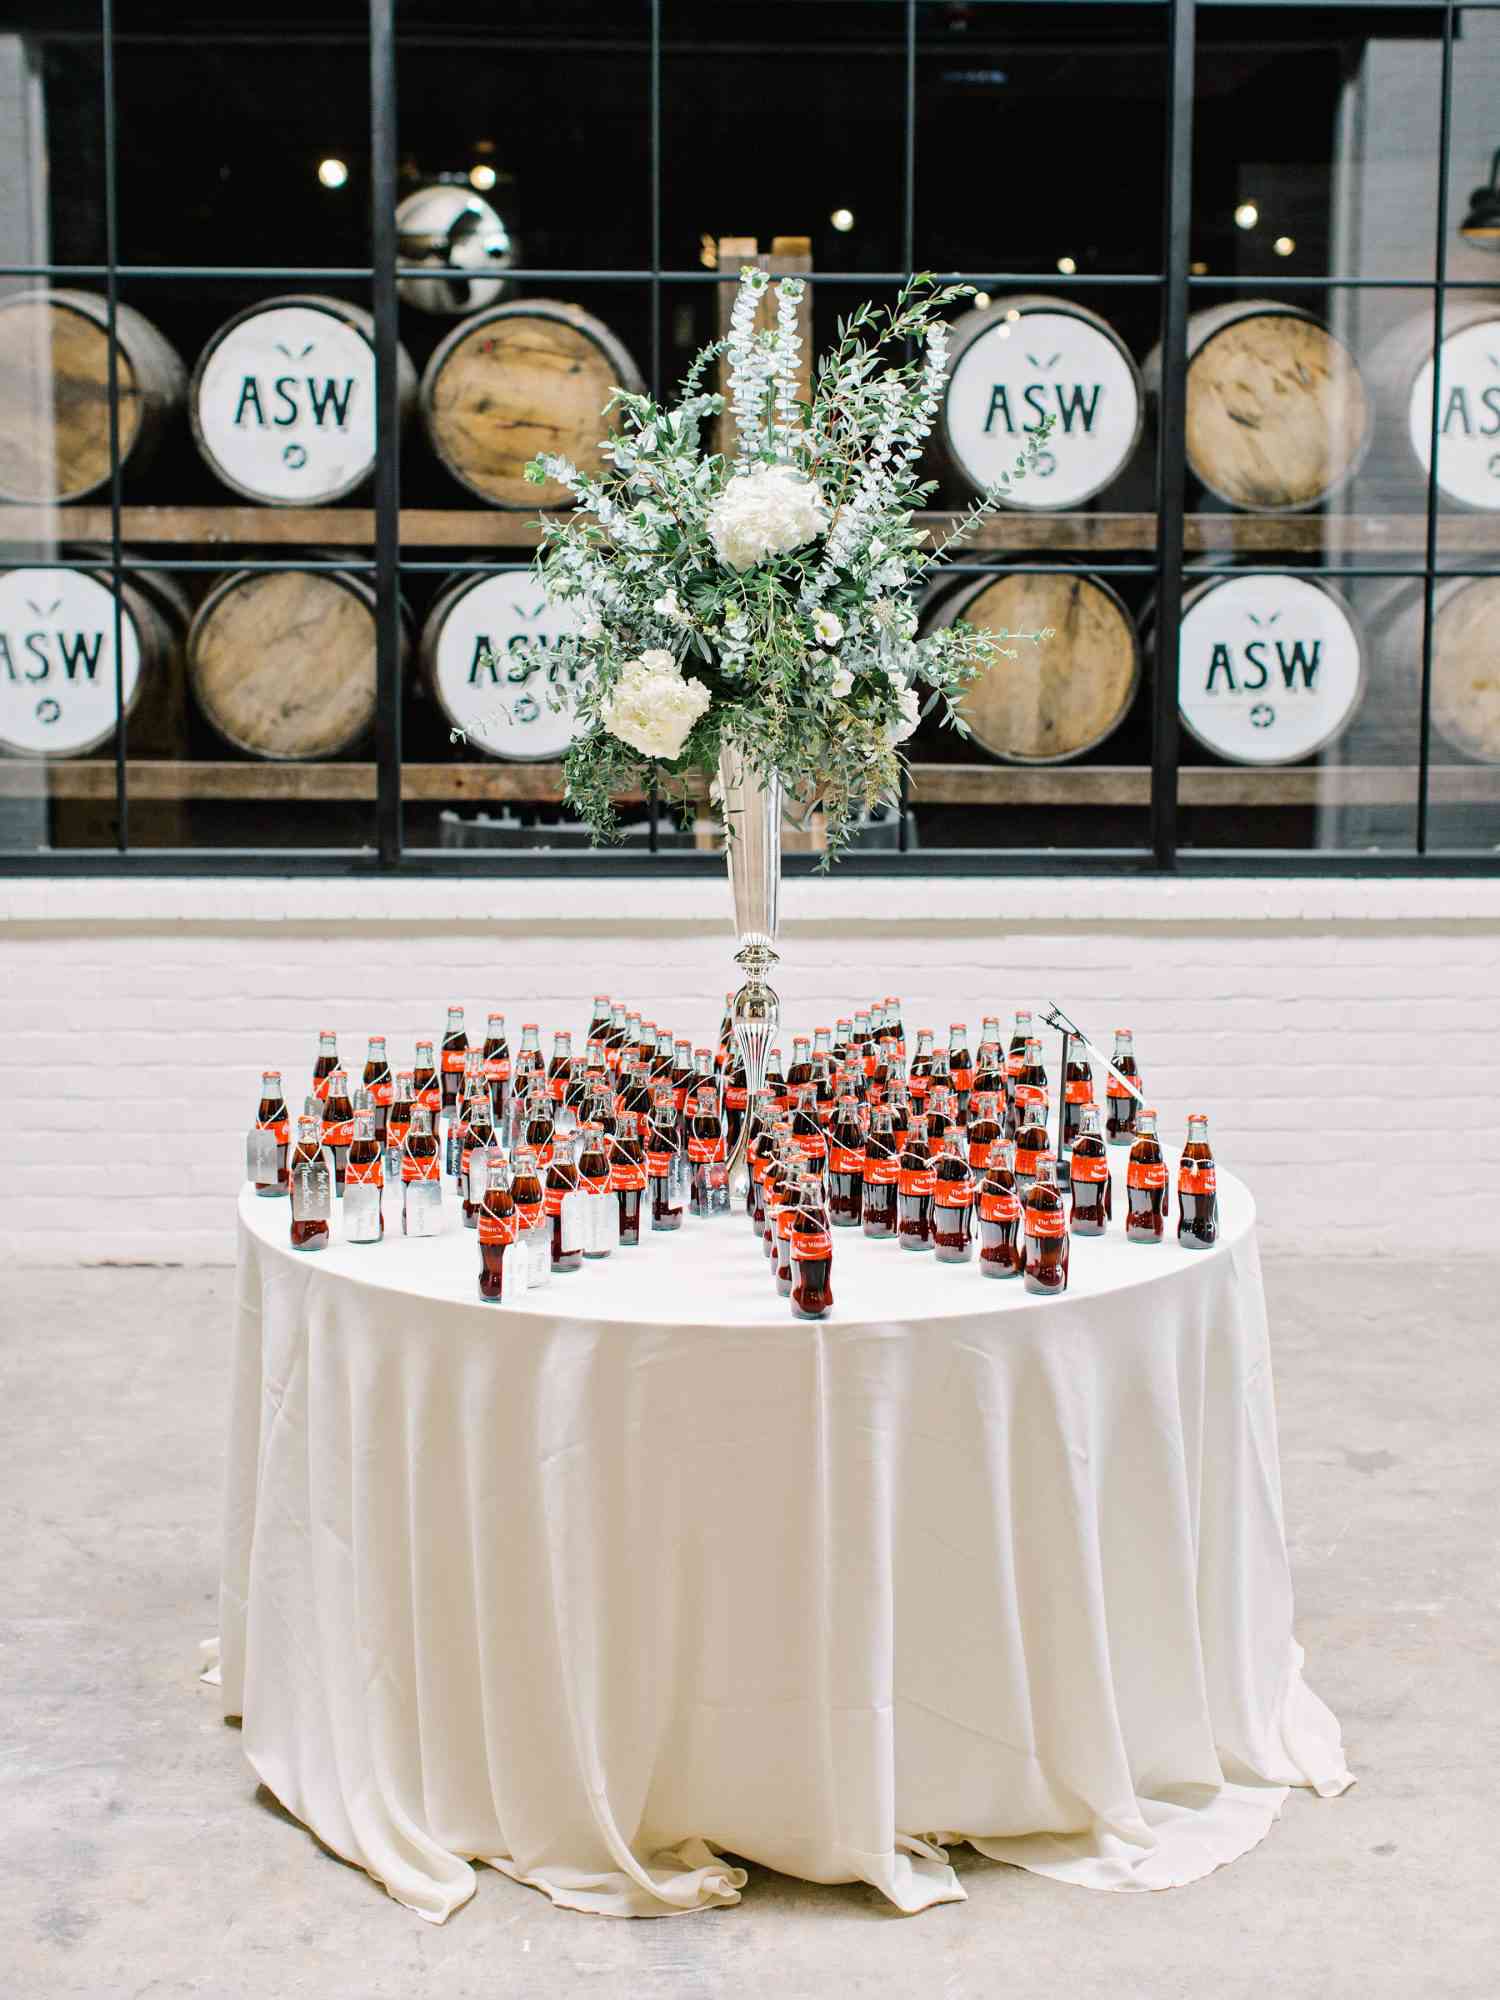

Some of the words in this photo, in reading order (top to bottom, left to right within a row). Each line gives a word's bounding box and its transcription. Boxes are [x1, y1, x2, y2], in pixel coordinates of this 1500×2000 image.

[235, 375, 355, 429] ASW
[984, 383, 1103, 434] ASW
[1206, 640, 1321, 692] ASW
